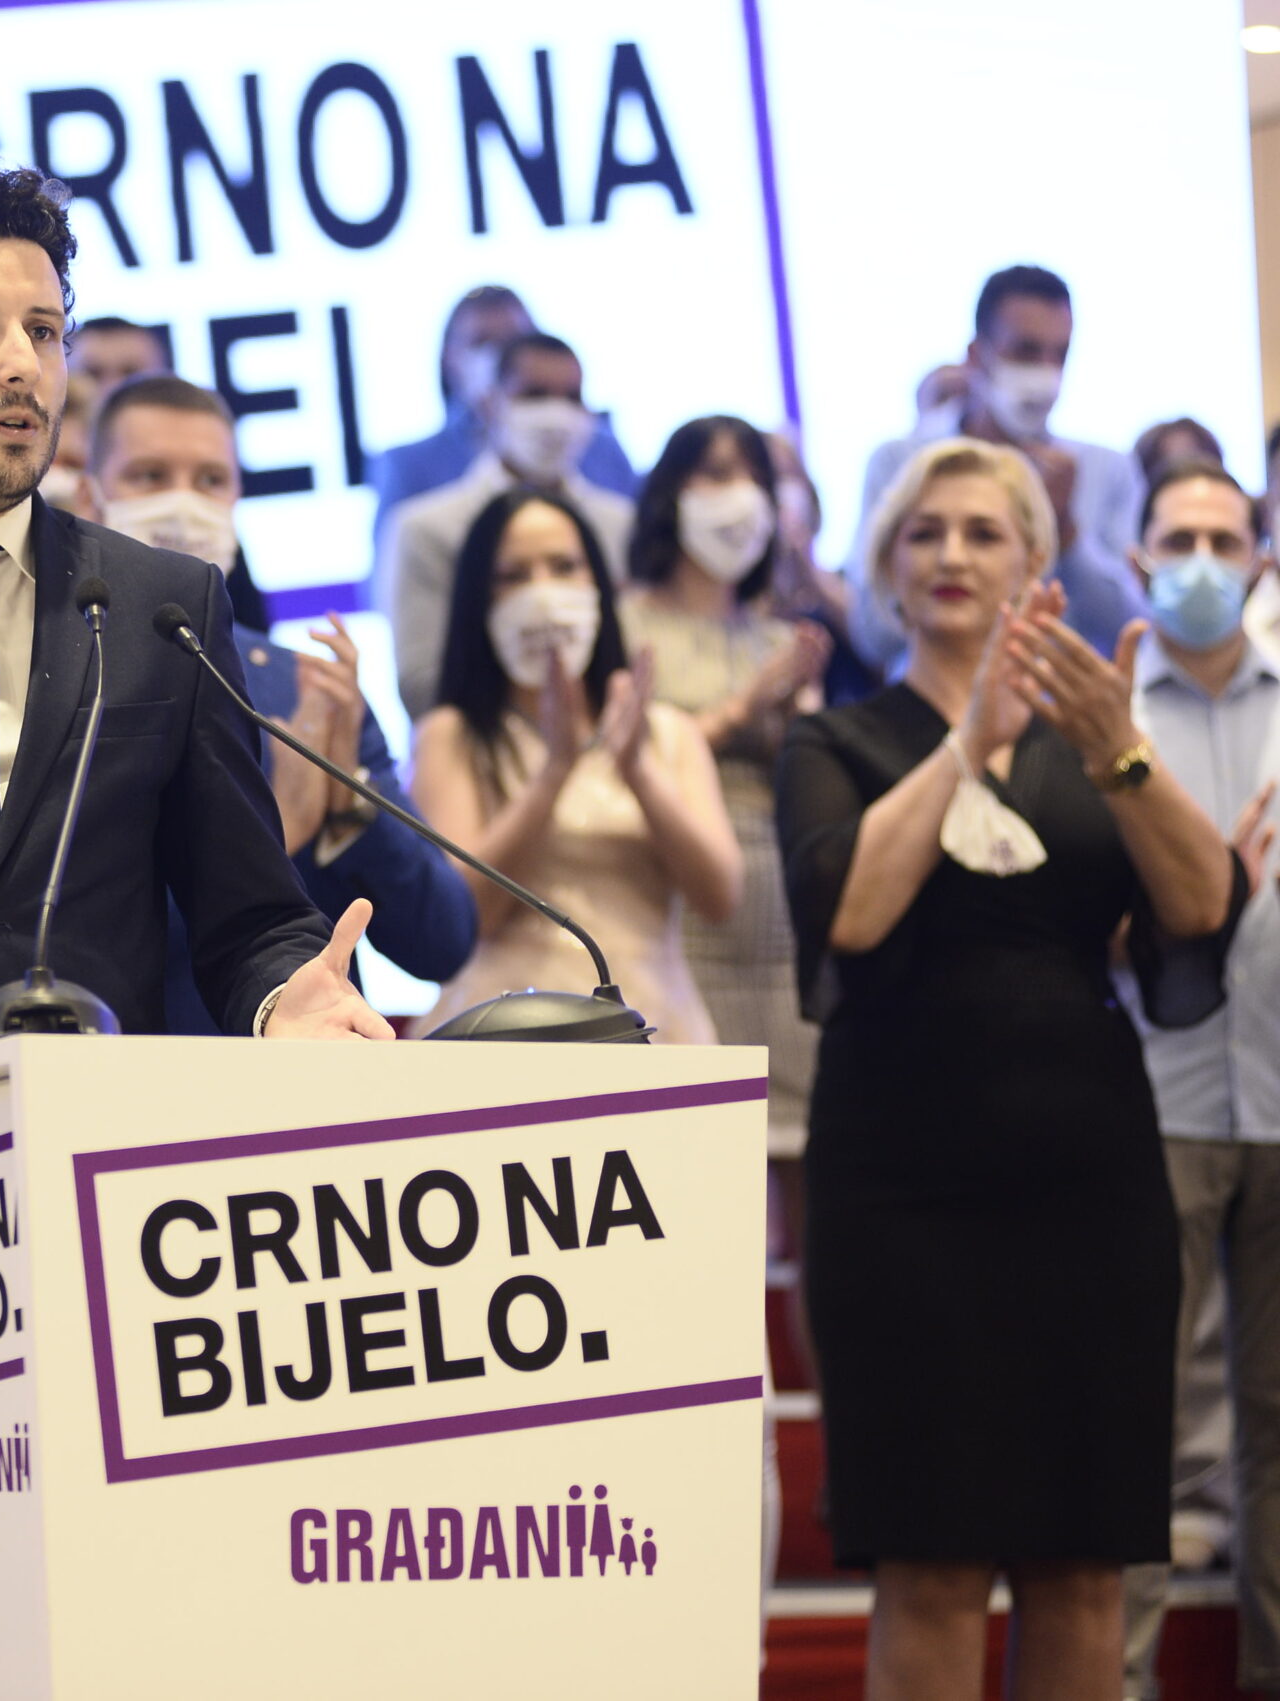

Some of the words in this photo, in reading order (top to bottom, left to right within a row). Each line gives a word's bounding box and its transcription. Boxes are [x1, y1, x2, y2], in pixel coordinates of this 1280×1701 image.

[457, 43, 694, 235] NA
[140, 1169, 479, 1298] CRNO
[502, 1149, 665, 1257] NA
[154, 1274, 609, 1418] BIJELO.
